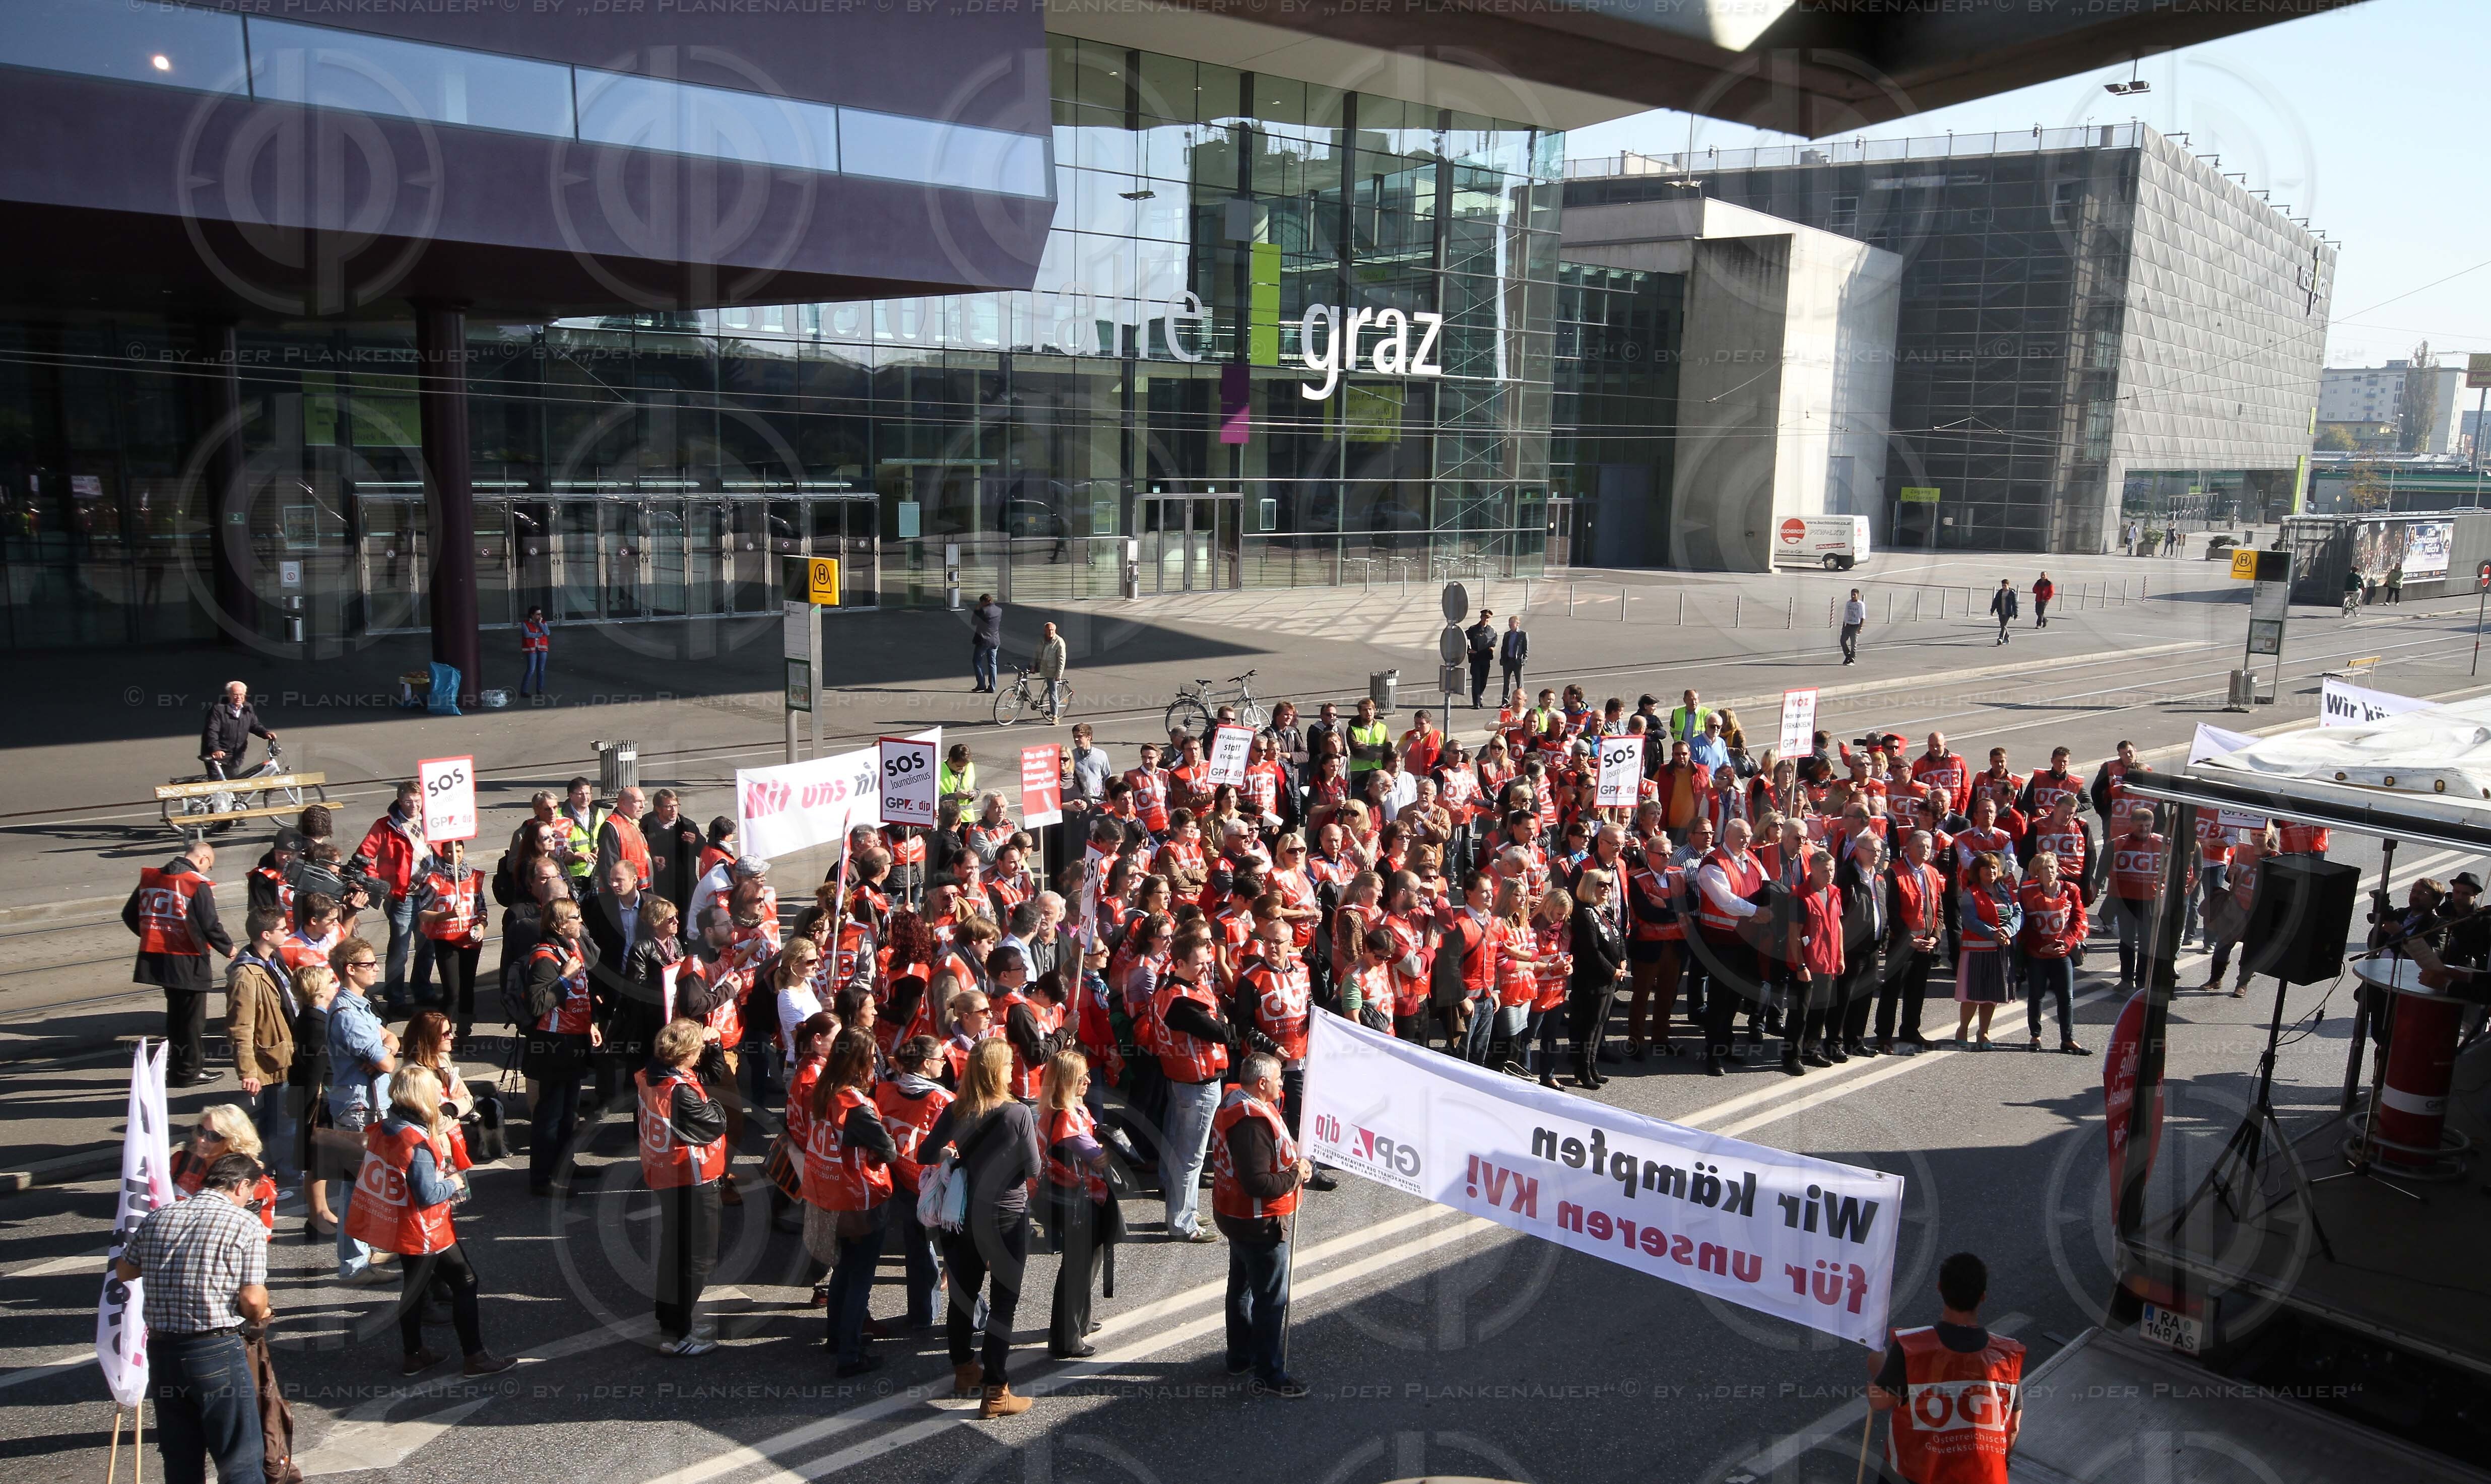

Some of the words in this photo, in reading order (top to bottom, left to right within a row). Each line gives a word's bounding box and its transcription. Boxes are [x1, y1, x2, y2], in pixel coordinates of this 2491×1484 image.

[1301, 302, 1443, 401] graz
[2427, 528, 2437, 536] Die
[2240, 556, 2248, 564] H
[818, 567, 826, 581] H
[1791, 696, 1809, 707] VÖZ
[2326, 693, 2357, 719] Wir
[1223, 743, 1241, 752] statt
[1023, 752, 1035, 760] Was
[1603, 745, 1635, 768] SOS
[885, 751, 925, 777] SOS
[1606, 761, 1640, 779] Journalismus
[427, 768, 465, 797] SOS
[890, 772, 931, 790] Journalismus
[1023, 772, 1044, 781] Meinung
[1626, 785, 1636, 794] djp
[745, 779, 792, 819] Mit
[801, 779, 847, 808] uns
[919, 800, 931, 812] djp
[2160, 1310, 2181, 1331] RA
[2146, 1321, 2172, 1341] 148
[2173, 1331, 2195, 1352] AS
[1933, 1431, 2007, 1444] Österreichisch
[1925, 1442, 2006, 1455] Gewerkschaftsb
